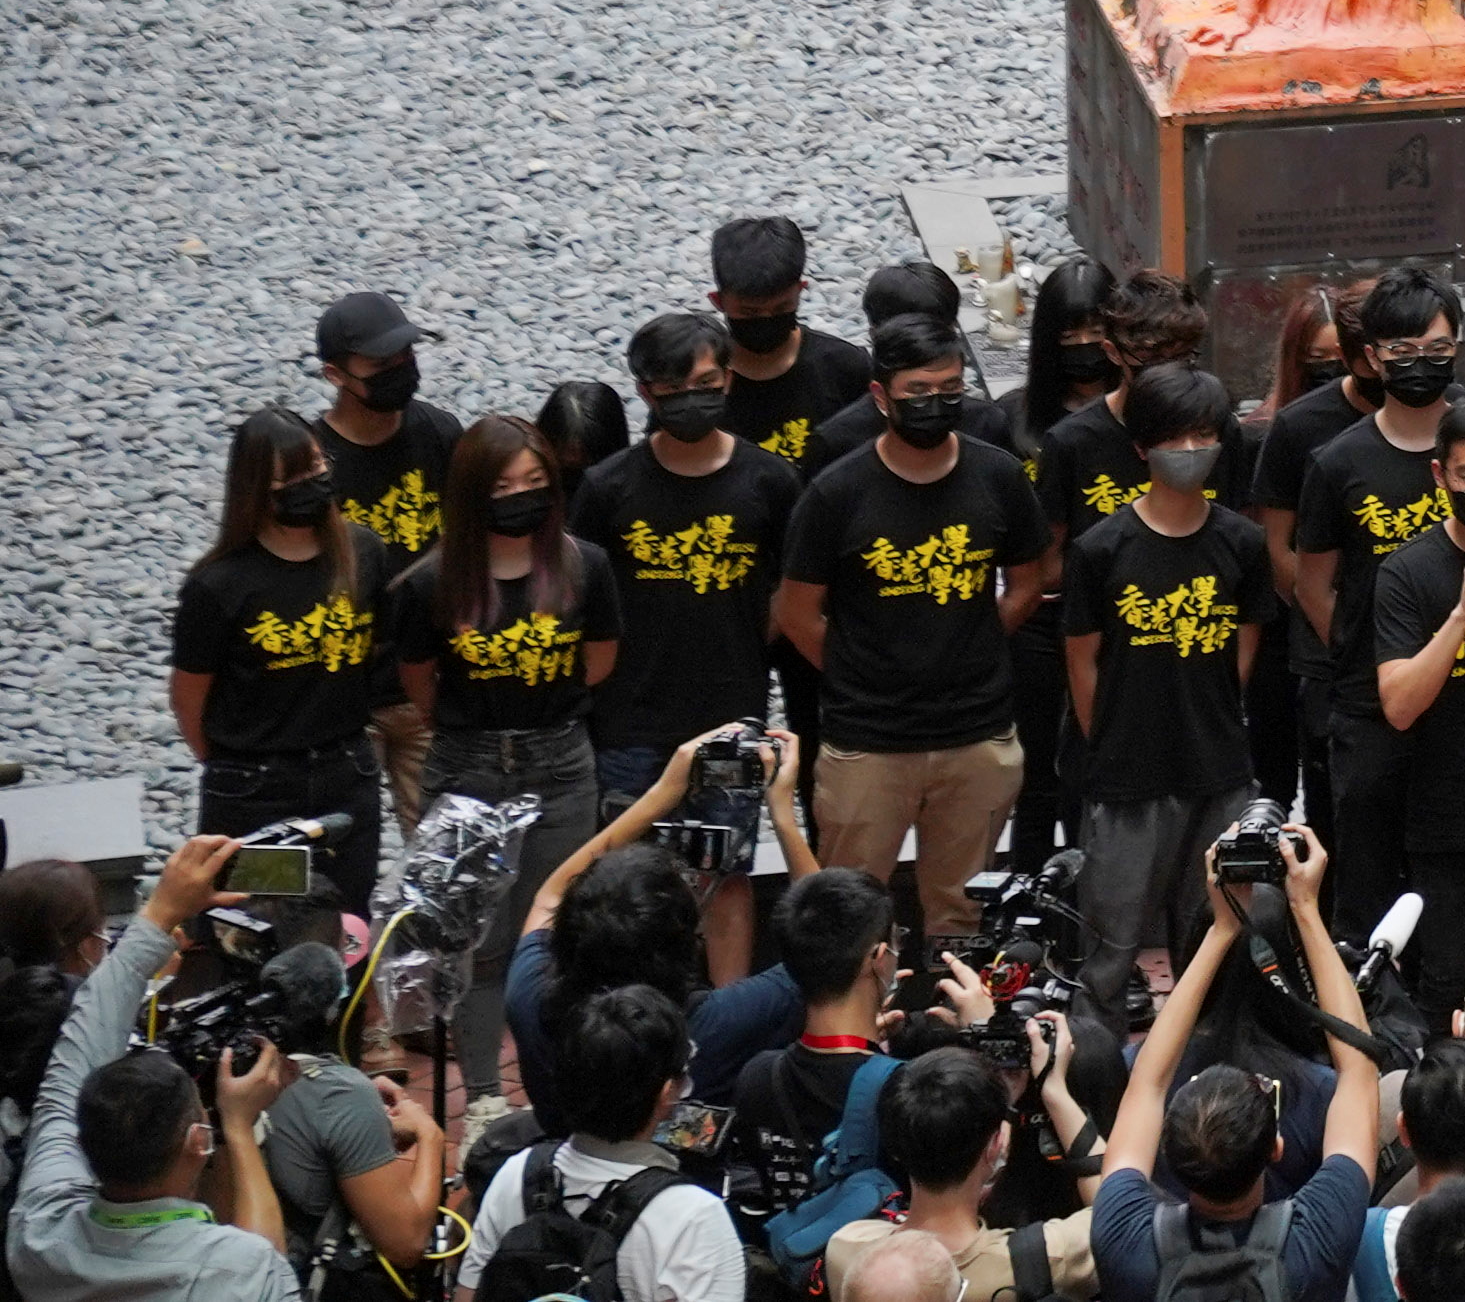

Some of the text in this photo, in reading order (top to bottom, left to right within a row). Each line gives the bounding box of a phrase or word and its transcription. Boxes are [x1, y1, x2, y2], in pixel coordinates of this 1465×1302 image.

[620, 514, 735, 569] 香港大學
[860, 523, 971, 584] 香港大學
[1114, 575, 1218, 632] 香港大學
